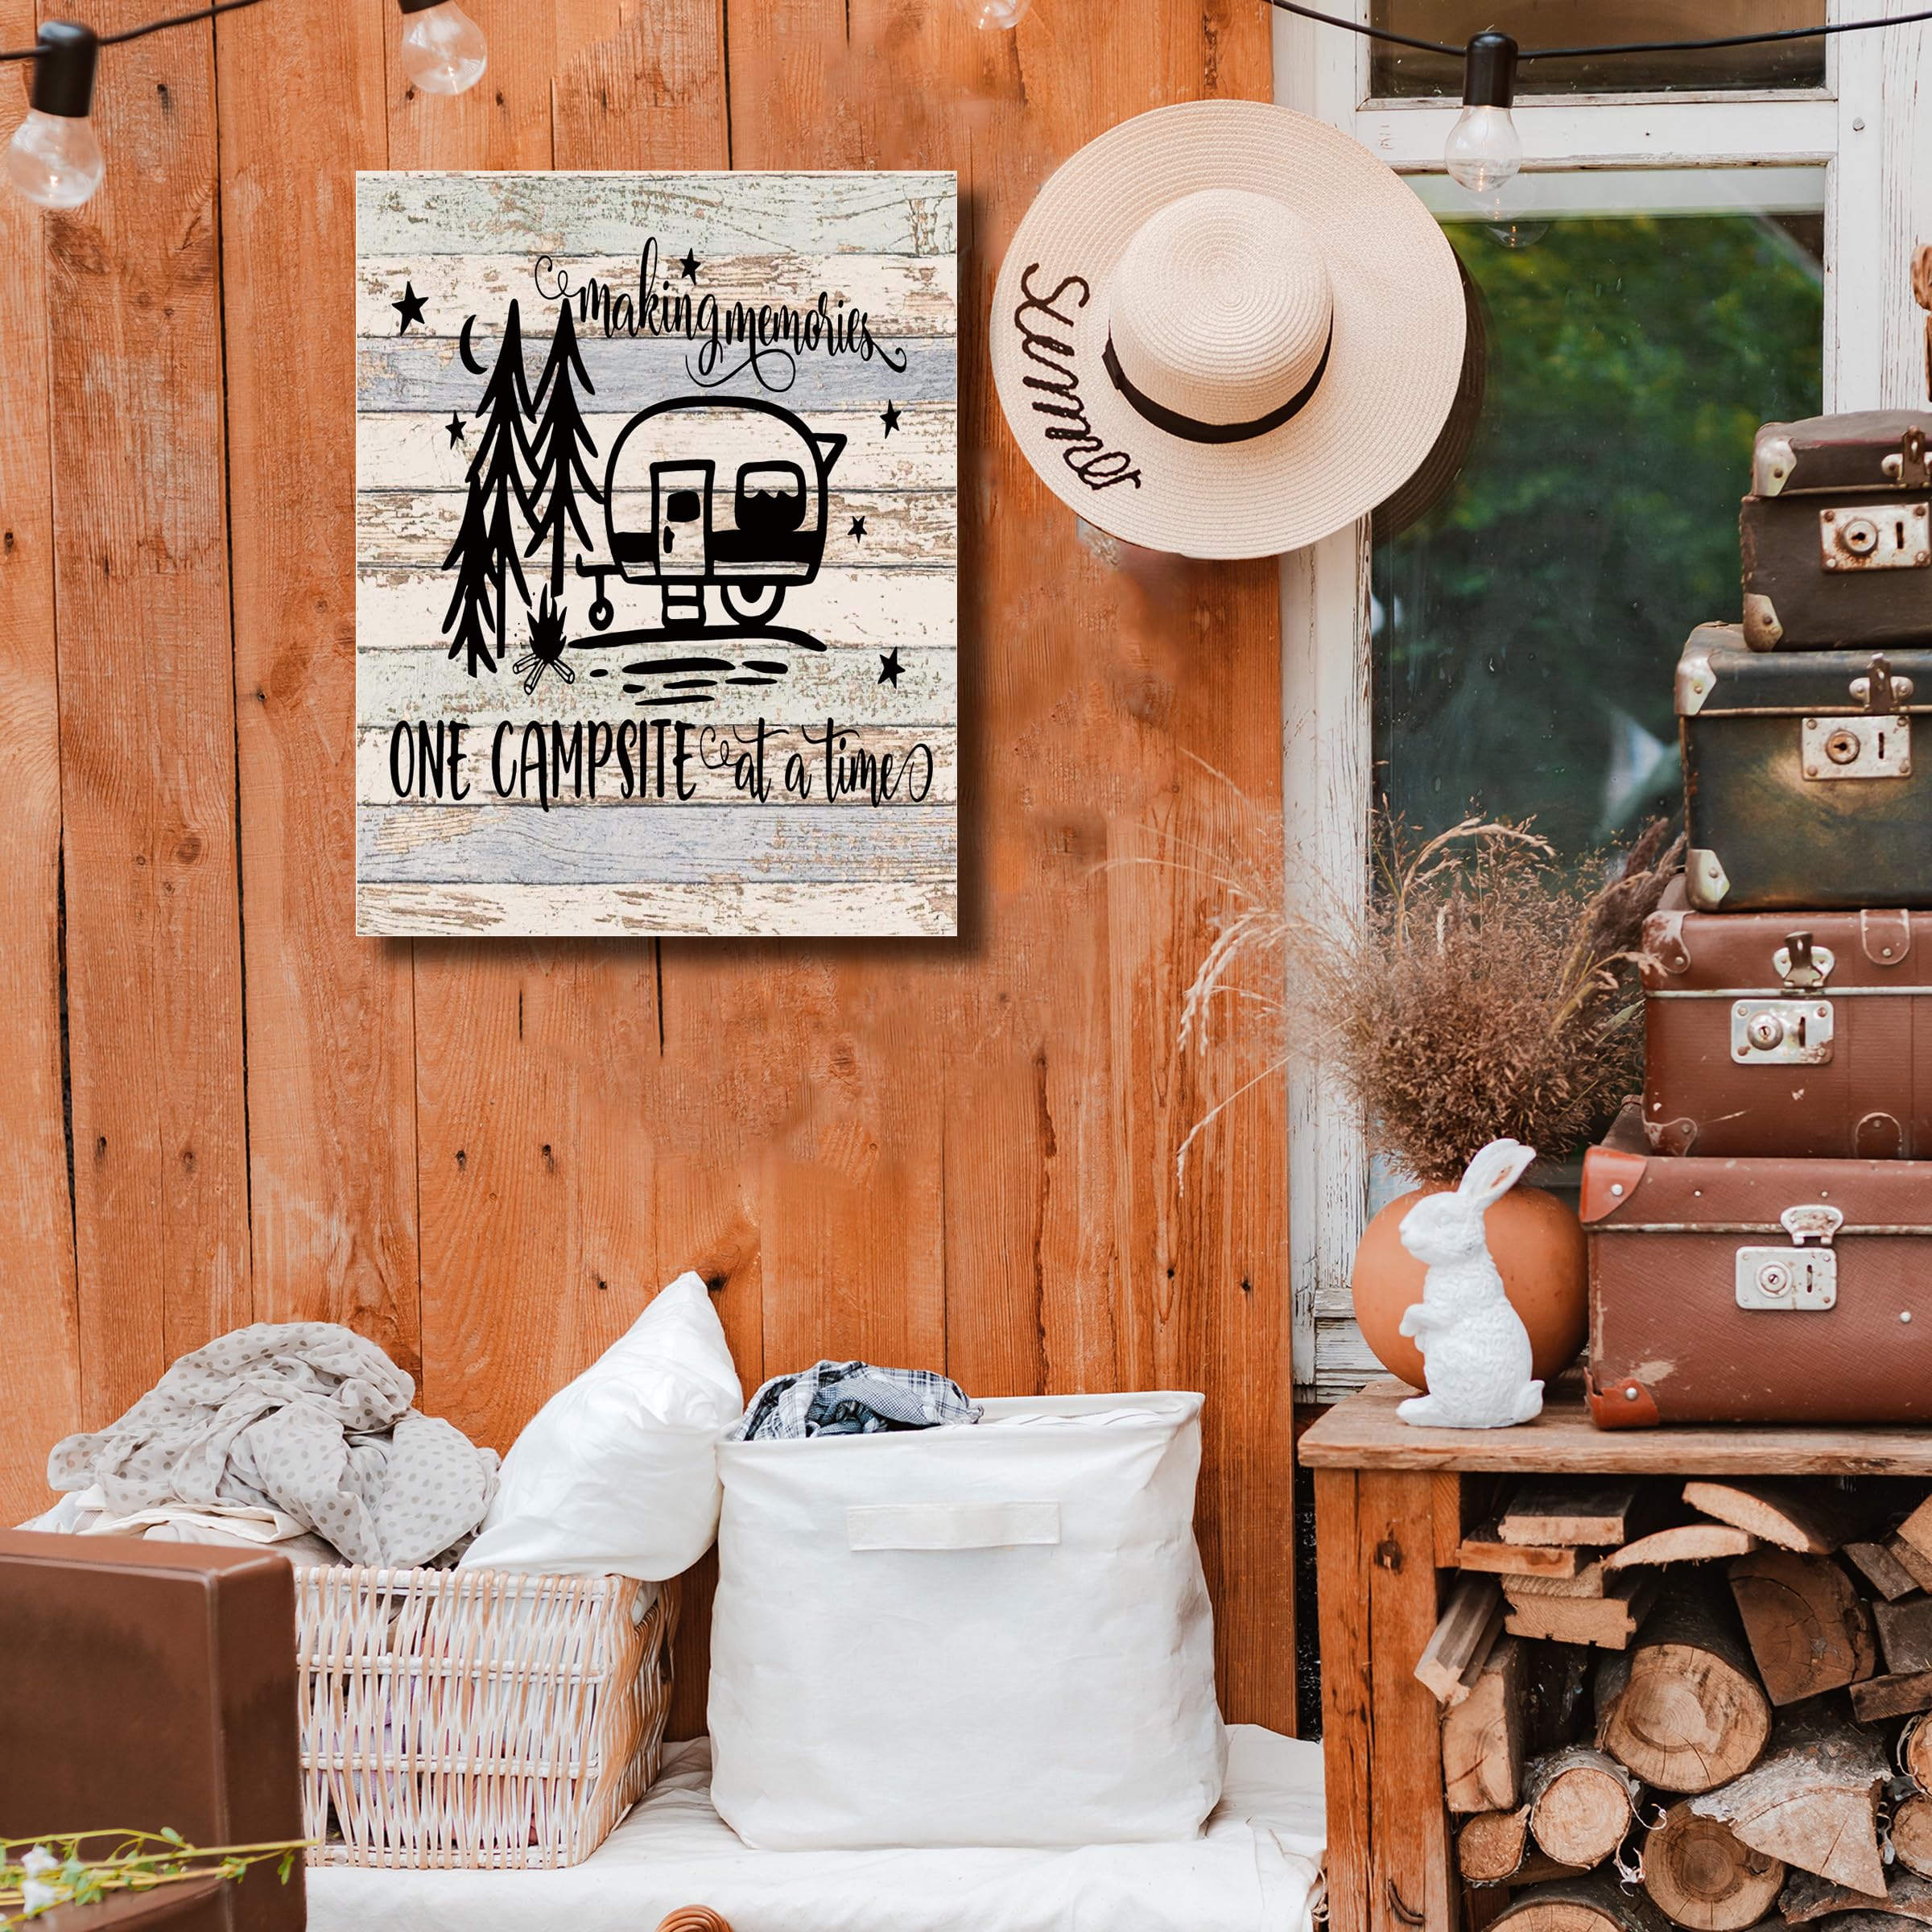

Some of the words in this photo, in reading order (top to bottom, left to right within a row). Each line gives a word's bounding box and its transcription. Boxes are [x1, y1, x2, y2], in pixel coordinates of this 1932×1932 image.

[534, 237, 724, 376] making
[686, 291, 907, 393] memories
[1013, 262, 1142, 491] Summer
[390, 719, 471, 802] ONE
[491, 718, 697, 813] CAMPSITE
[700, 716, 790, 804] at
[784, 753, 813, 800] a
[802, 717, 934, 808] time
